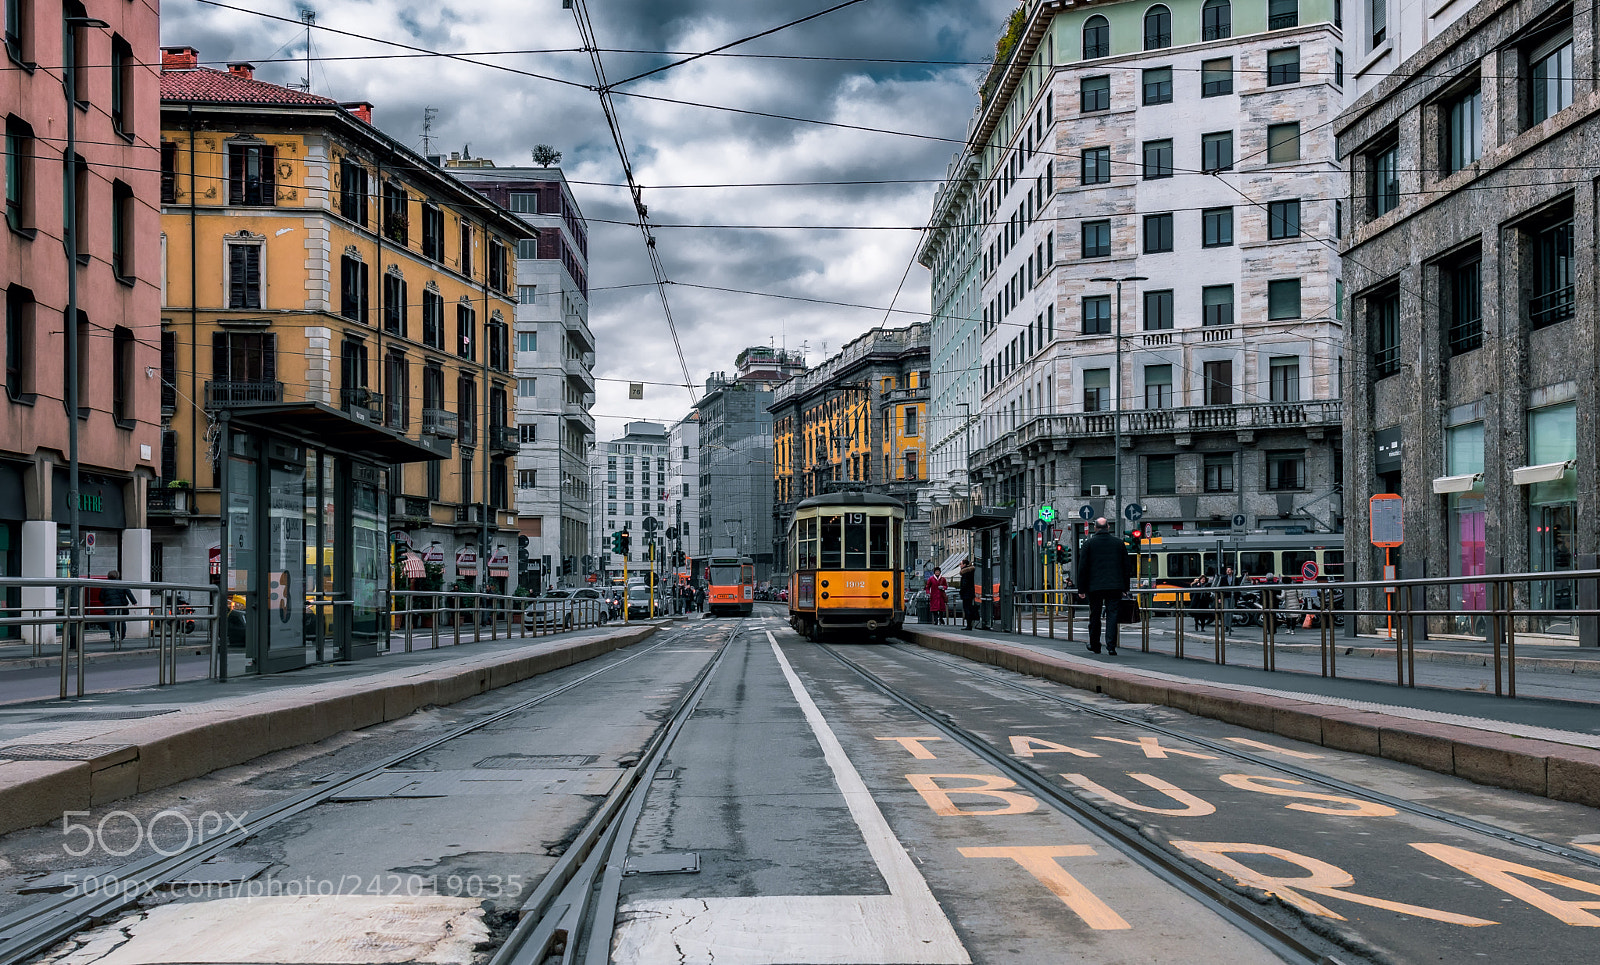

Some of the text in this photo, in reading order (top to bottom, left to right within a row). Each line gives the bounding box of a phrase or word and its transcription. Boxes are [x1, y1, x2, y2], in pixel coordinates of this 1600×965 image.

[849, 513, 863, 524] 19
[874, 735, 1325, 760] TAXI
[904, 773, 1399, 818] BUS
